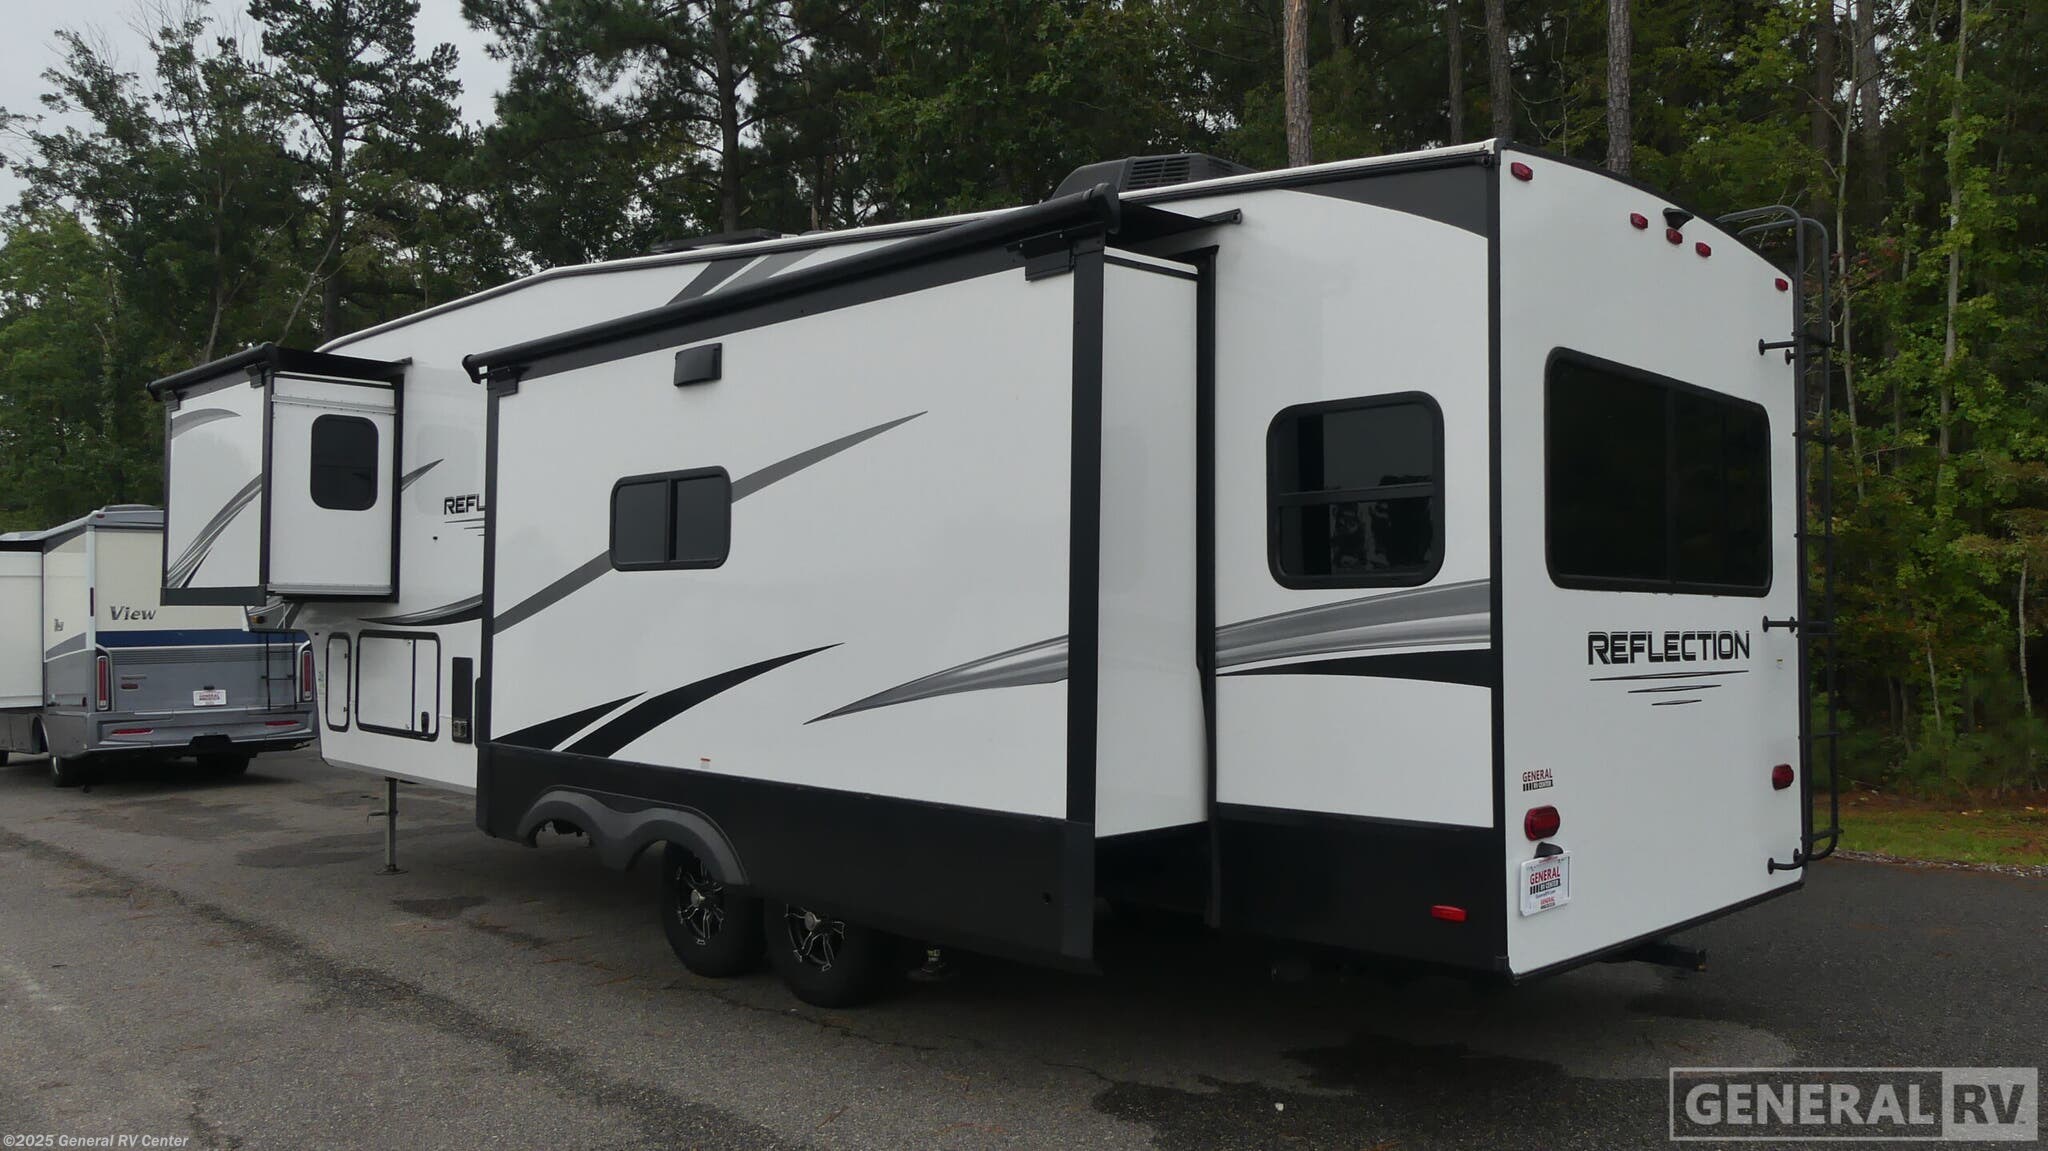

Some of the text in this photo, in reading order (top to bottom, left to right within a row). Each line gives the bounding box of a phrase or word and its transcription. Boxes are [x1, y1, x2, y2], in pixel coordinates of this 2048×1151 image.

[110, 605, 156, 620] View
[1588, 631, 1750, 665] REFLECTION
[1523, 768, 1553, 782] GENERAL
[1530, 866, 1560, 885] GENERAL
